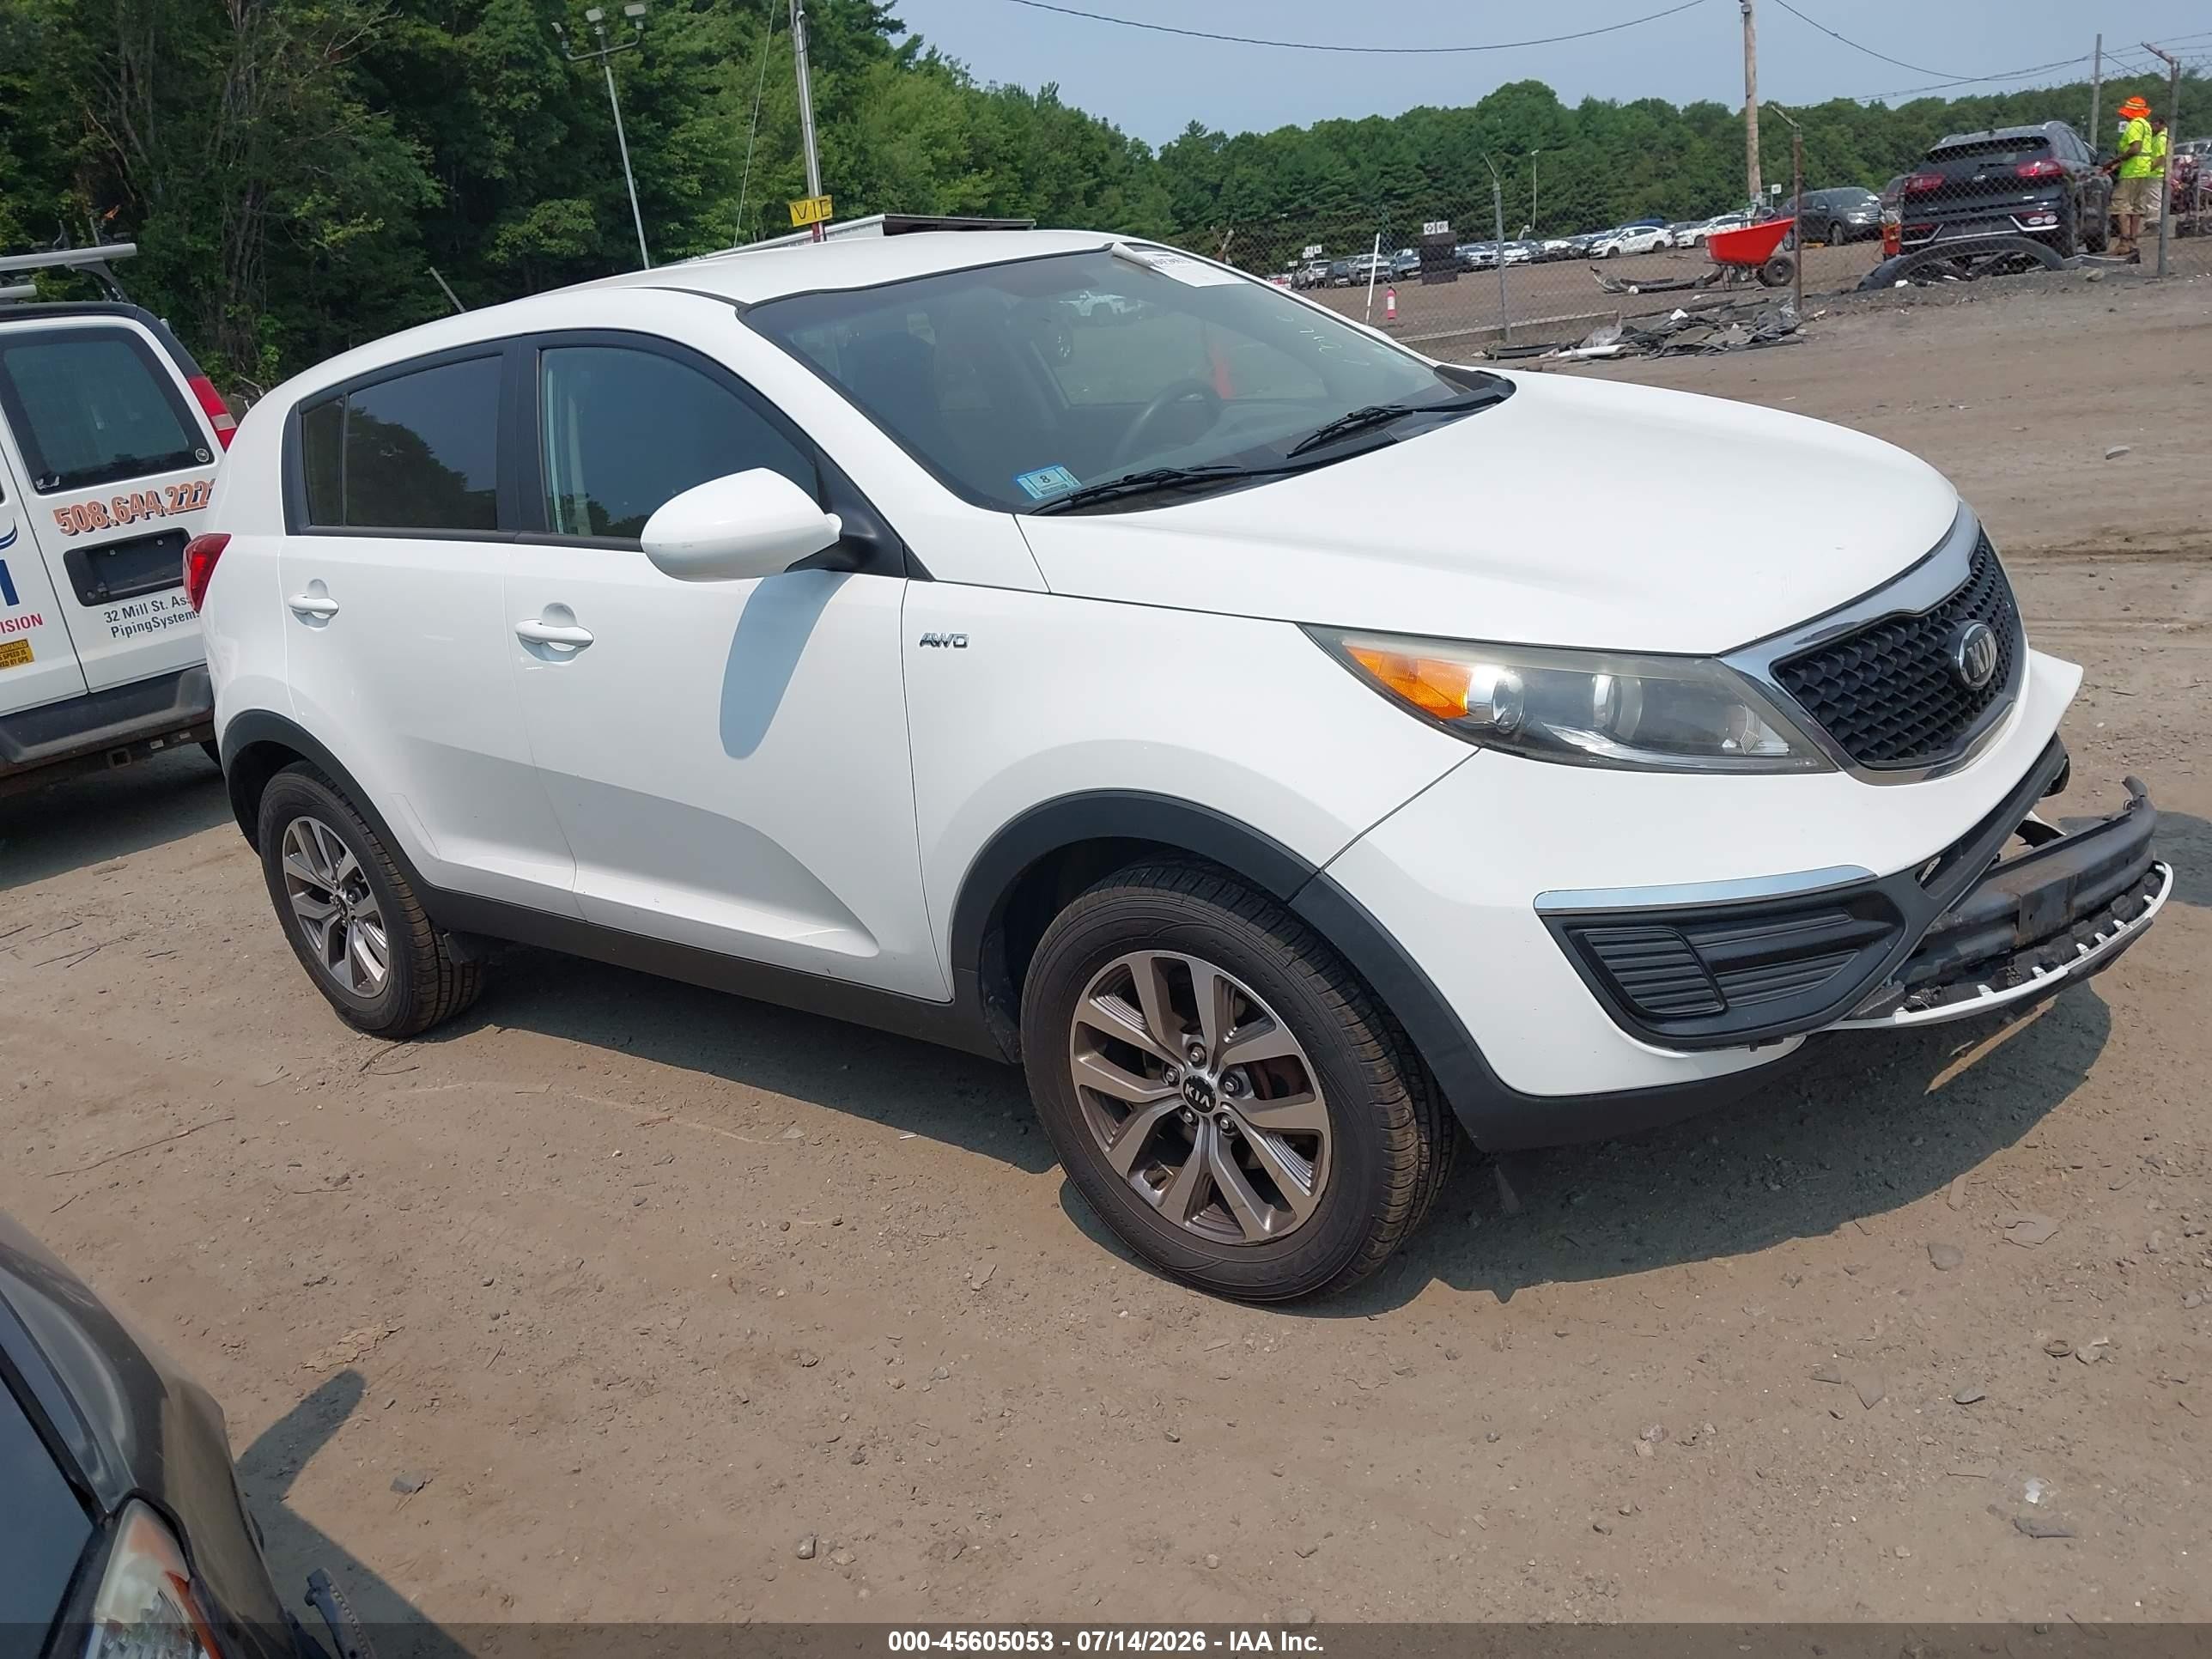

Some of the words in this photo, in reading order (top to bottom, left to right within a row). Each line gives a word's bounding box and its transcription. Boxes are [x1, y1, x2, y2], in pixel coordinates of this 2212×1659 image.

[1039, 475, 1051, 483] 8
[104, 610, 120, 623] 32
[122, 603, 149, 619] Mill
[151, 599, 168, 612] St.
[919, 632, 969, 648] AWD
[1184, 1083, 1211, 1109] KIA
